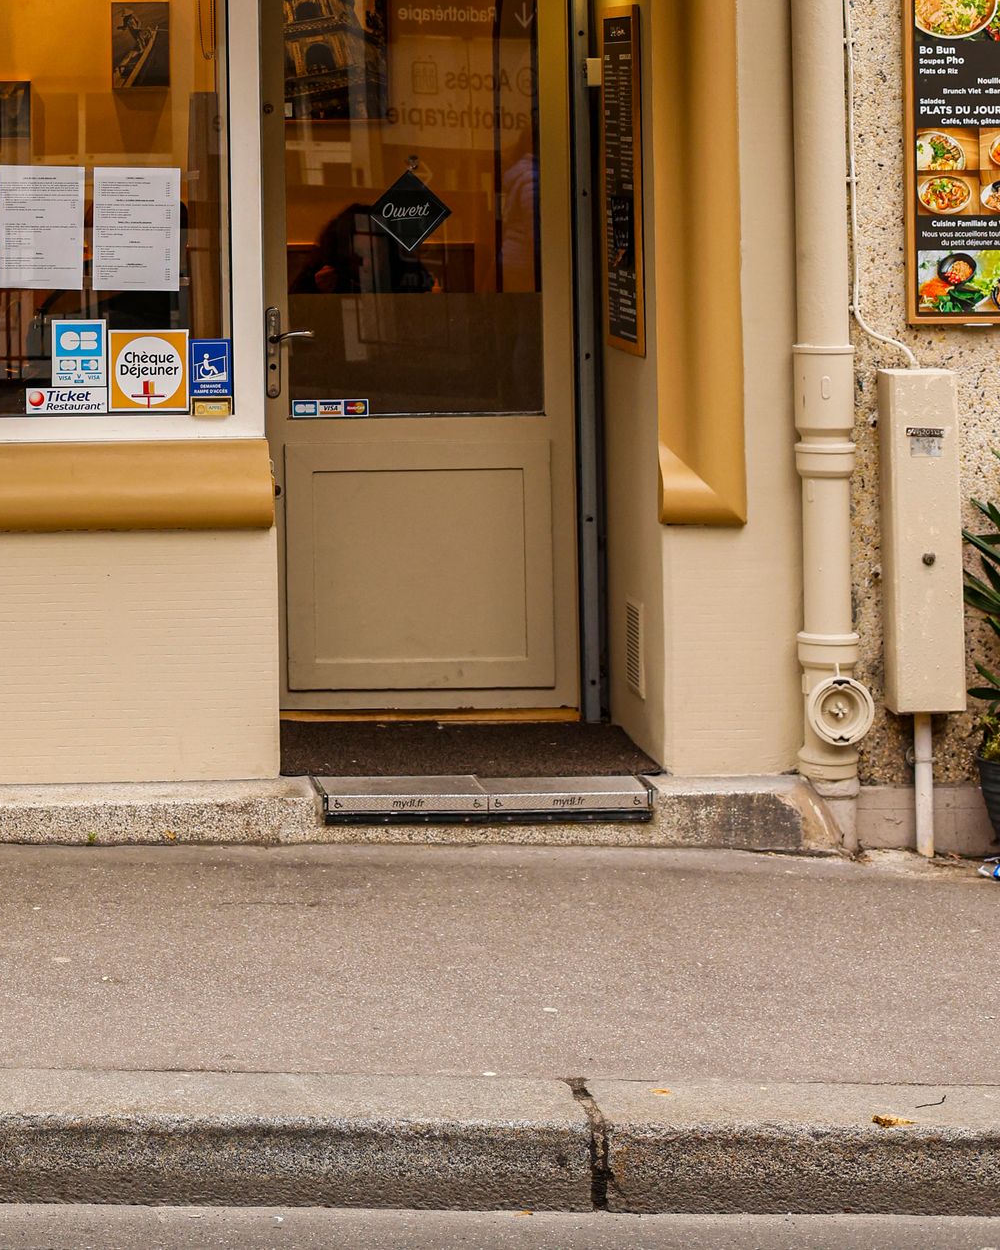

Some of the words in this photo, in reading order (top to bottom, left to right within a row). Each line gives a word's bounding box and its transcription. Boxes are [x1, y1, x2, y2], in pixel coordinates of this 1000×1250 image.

[919, 46, 933, 54] Bo
[936, 46, 956, 54] Bun
[946, 56, 964, 64] Pho
[920, 106, 952, 114] PLATS
[955, 106, 971, 114] DU
[382, 202, 430, 218] Ouvert
[124, 351, 175, 365] Chèque
[120, 364, 179, 378] Déjeuner
[46, 391, 91, 402] Ticket
